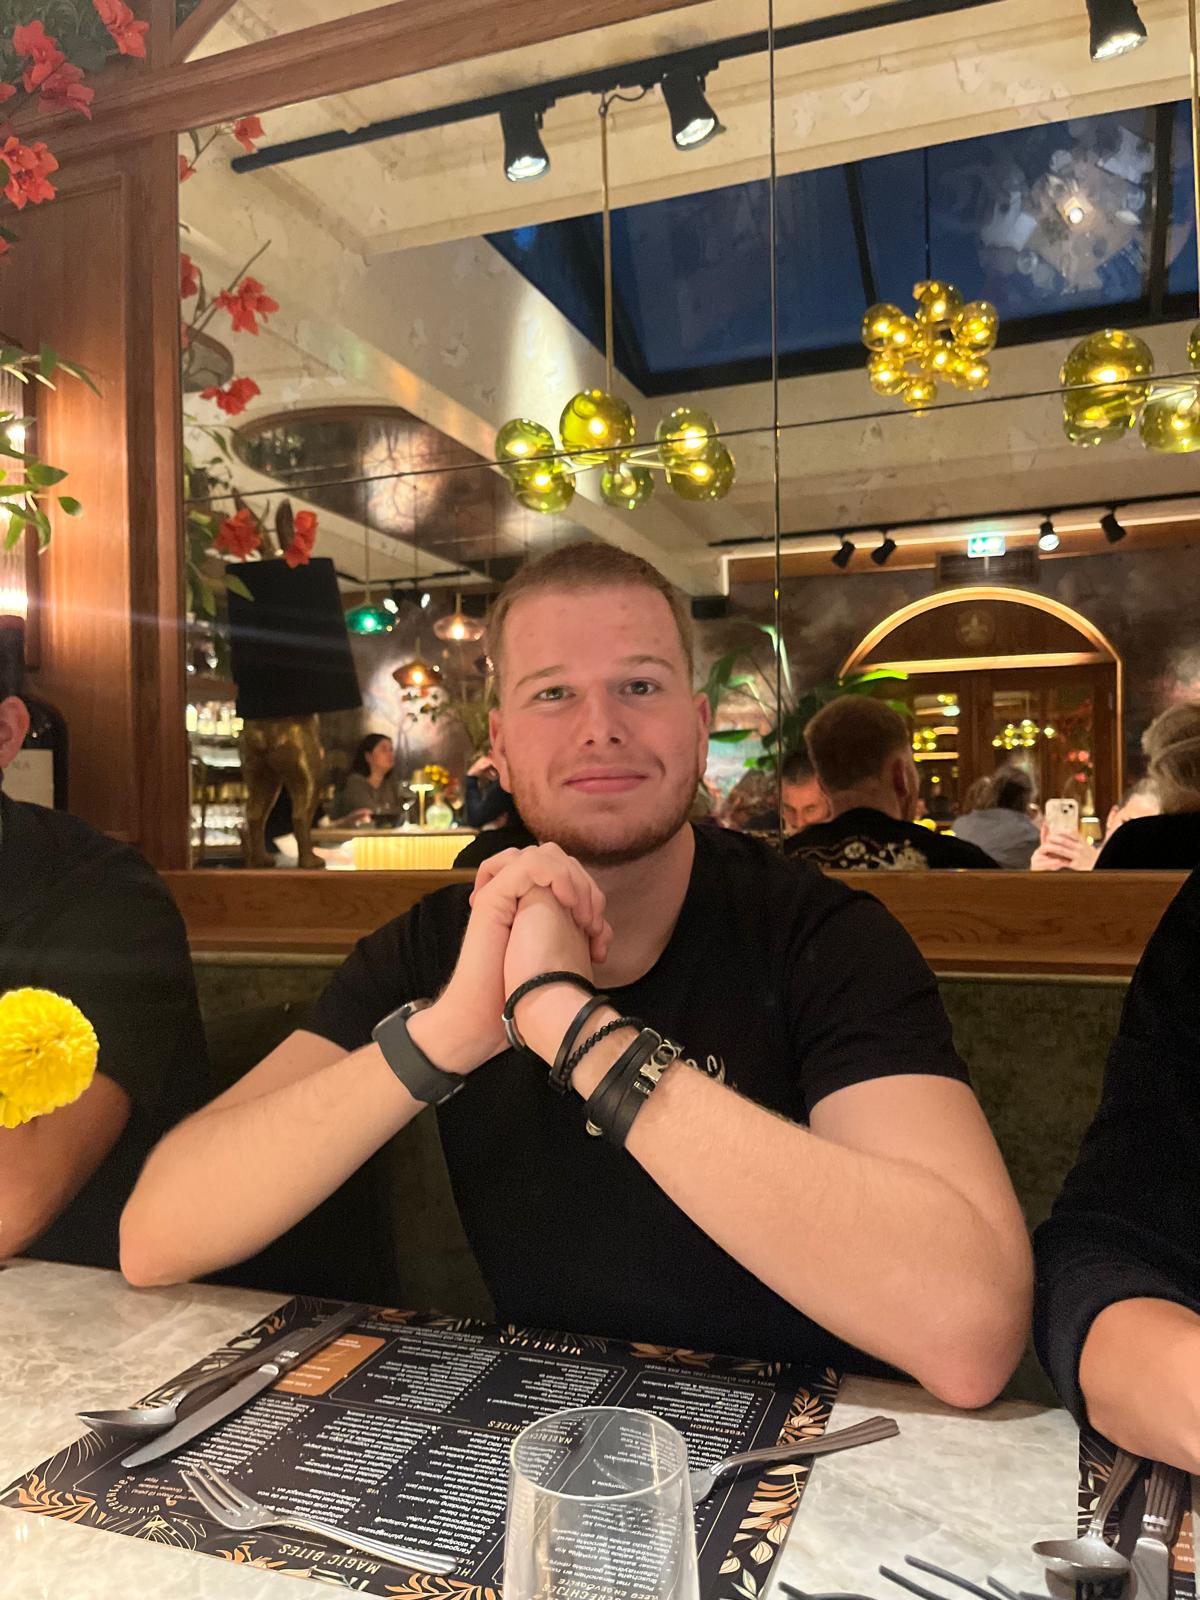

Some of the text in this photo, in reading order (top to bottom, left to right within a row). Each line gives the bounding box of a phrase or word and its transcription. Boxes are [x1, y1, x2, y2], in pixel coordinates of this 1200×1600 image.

[690, 1422, 747, 1438] VEGETARISCH
[705, 1441, 729, 1449] Gravad
[288, 1497, 313, 1506] chicken
[441, 1501, 471, 1511] Rendang
[329, 1506, 349, 1514] Sweet
[278, 1544, 380, 1574] MAGIC BITES
